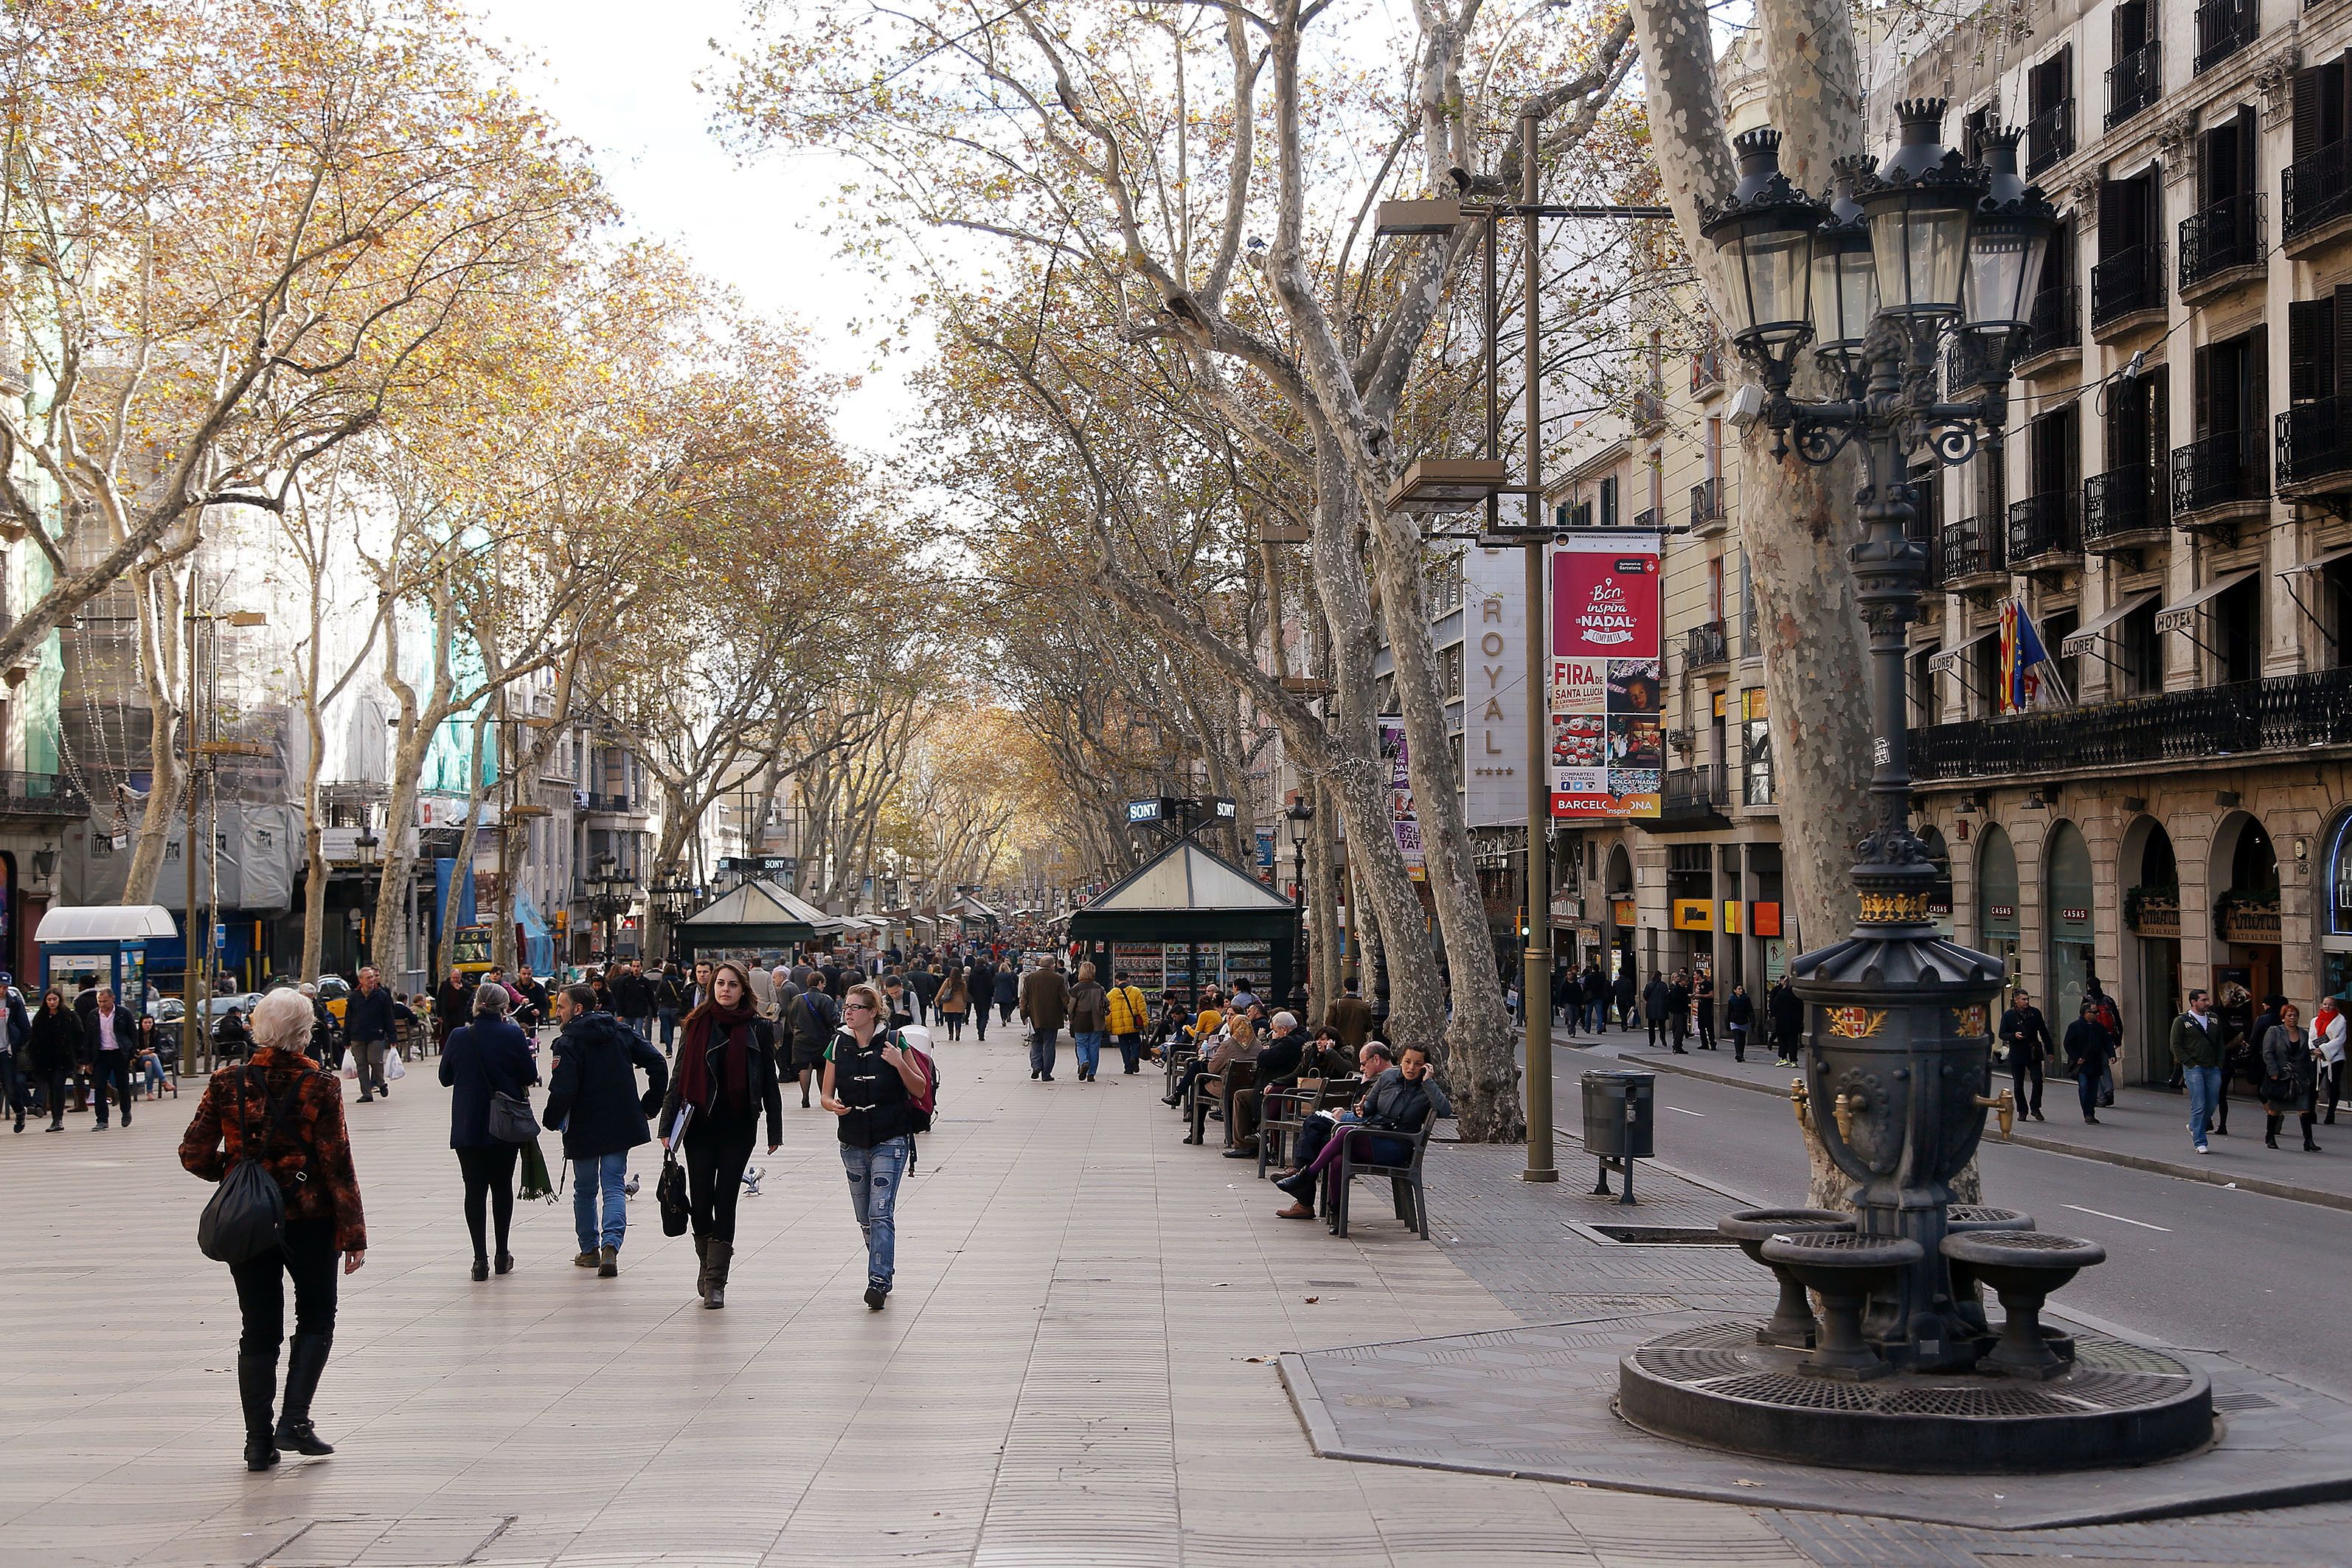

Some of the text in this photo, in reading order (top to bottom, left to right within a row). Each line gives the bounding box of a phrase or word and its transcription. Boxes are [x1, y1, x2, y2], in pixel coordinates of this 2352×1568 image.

[1593, 585, 1620, 601] Bcn
[1586, 603, 1628, 614] inspira
[1581, 615, 1634, 628] NADAL
[2157, 611, 2191, 631] HOTEL
[1592, 631, 1621, 642] COMPARTIR
[1481, 598, 1504, 754] ROYAL
[1555, 662, 1603, 685] FIRA DE
[1555, 685, 1604, 699] SANTA LLÚCIA
[1129, 802, 1158, 819] SONY
[1216, 802, 1235, 817] SONY
[1606, 807, 1631, 815] inspira
[1400, 839, 1420, 850] TAT
[764, 859, 785, 869] SONY
[1929, 905, 1947, 913] CASAS
[1991, 906, 2011, 915] CASAS
[2062, 909, 2085, 918] CASAS
[2137, 905, 2180, 926] Amorin
[2226, 907, 2281, 930] Amorin
